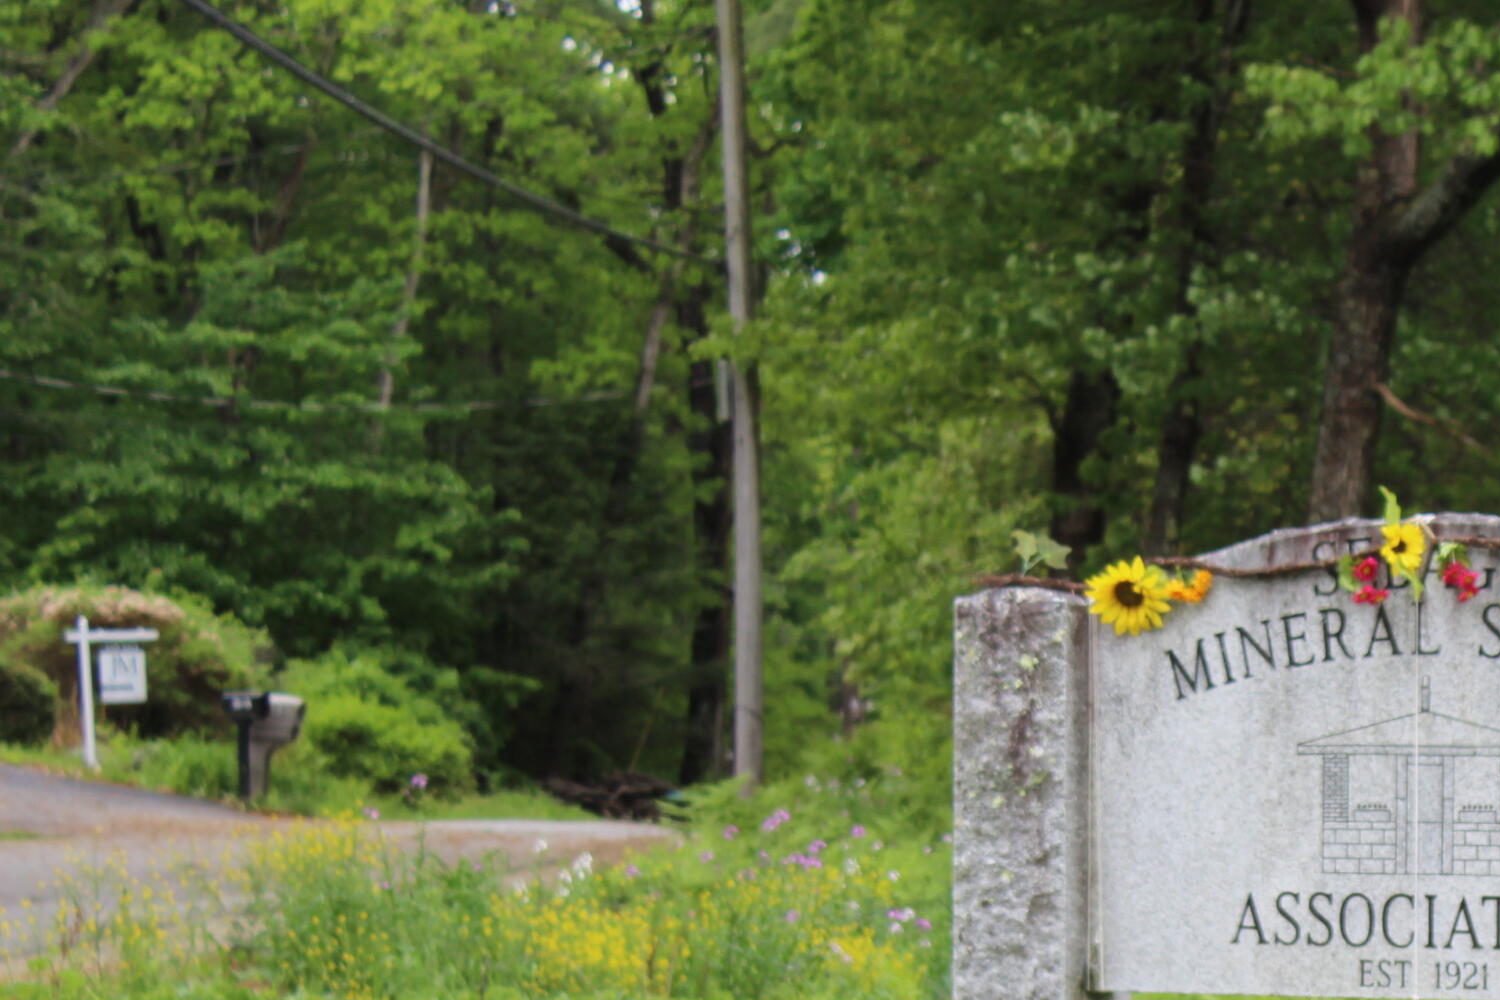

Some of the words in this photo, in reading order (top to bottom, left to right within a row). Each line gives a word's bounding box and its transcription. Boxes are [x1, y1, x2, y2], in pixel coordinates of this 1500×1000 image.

[1165, 601, 1442, 701] MINERAL
[1359, 958, 1412, 989] EST
[1435, 959, 1488, 990] 1921
